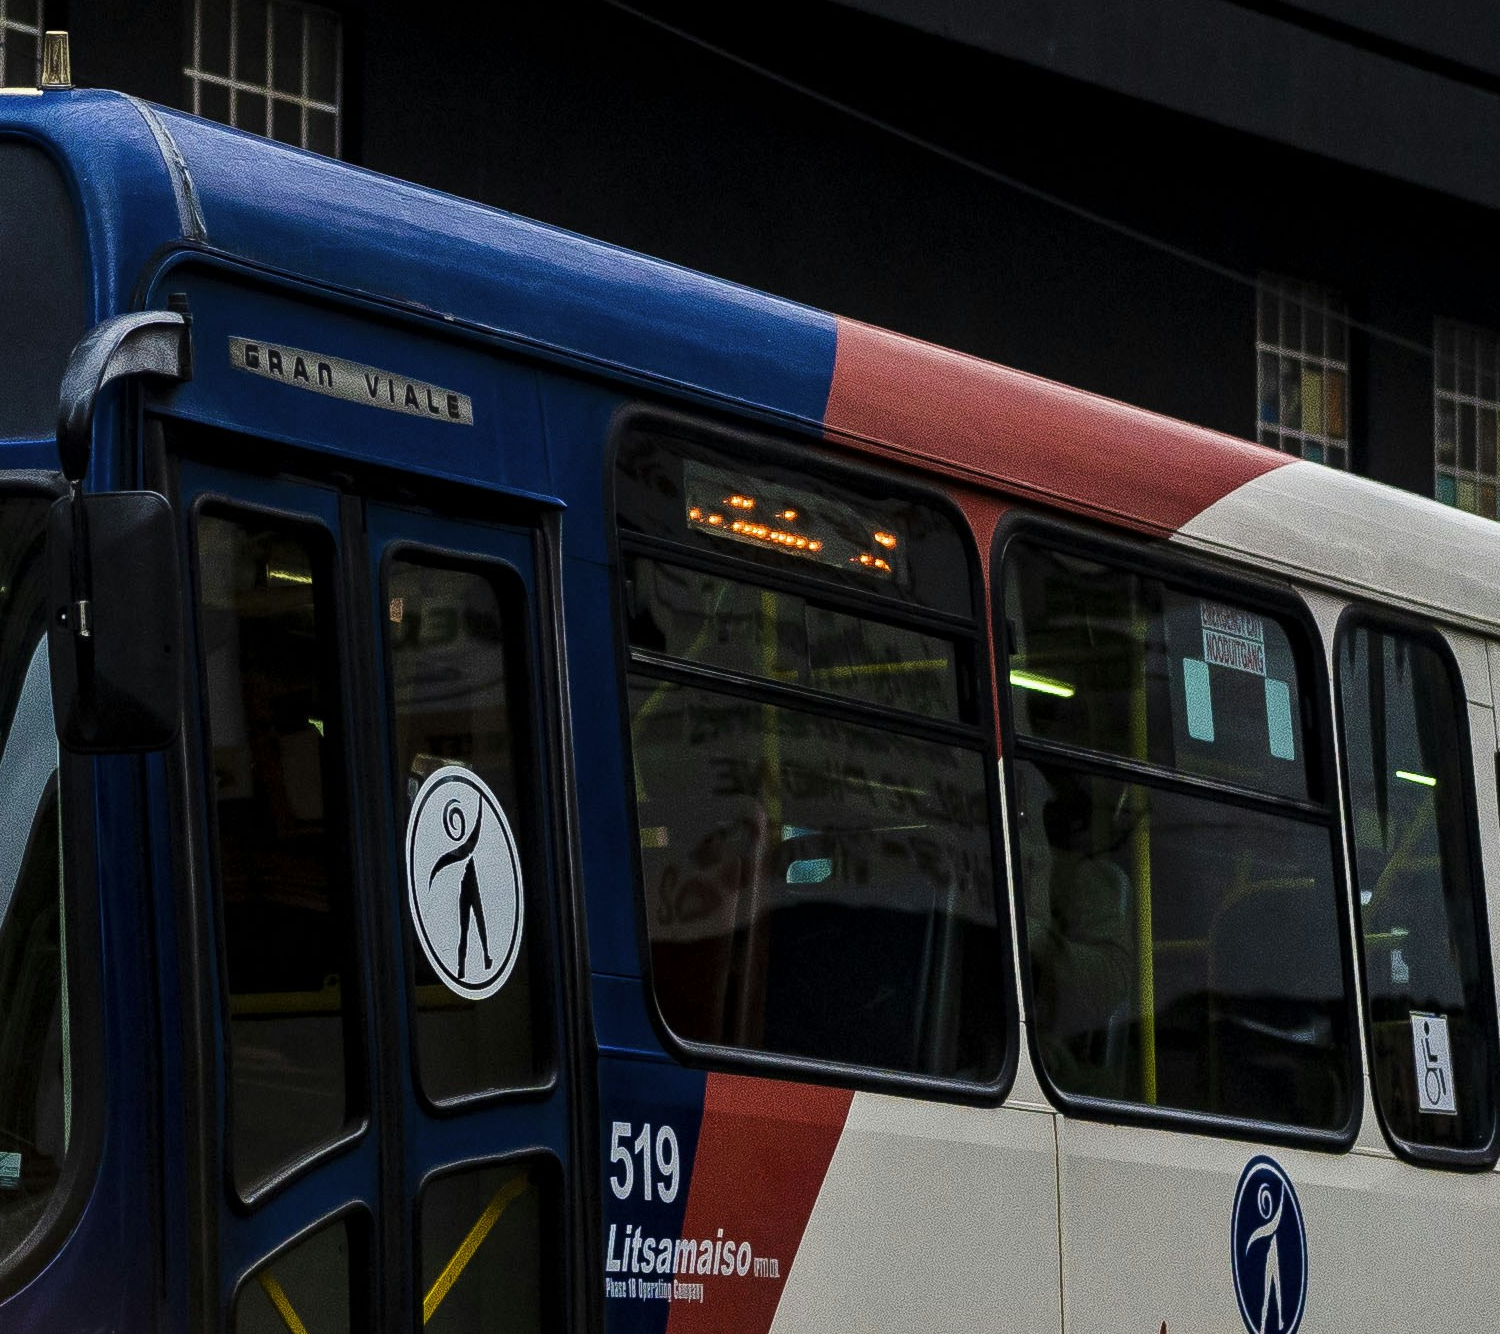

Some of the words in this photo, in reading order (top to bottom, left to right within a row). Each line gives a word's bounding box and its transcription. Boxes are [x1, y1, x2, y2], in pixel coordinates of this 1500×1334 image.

[364, 369, 461, 421] VIALE
[608, 1120, 681, 1204] 519
[605, 1224, 753, 1277] Litsamaiso
[605, 1277, 627, 1299] Phase
[638, 1278, 672, 1303] Operating
[673, 1279, 704, 1303] Company
